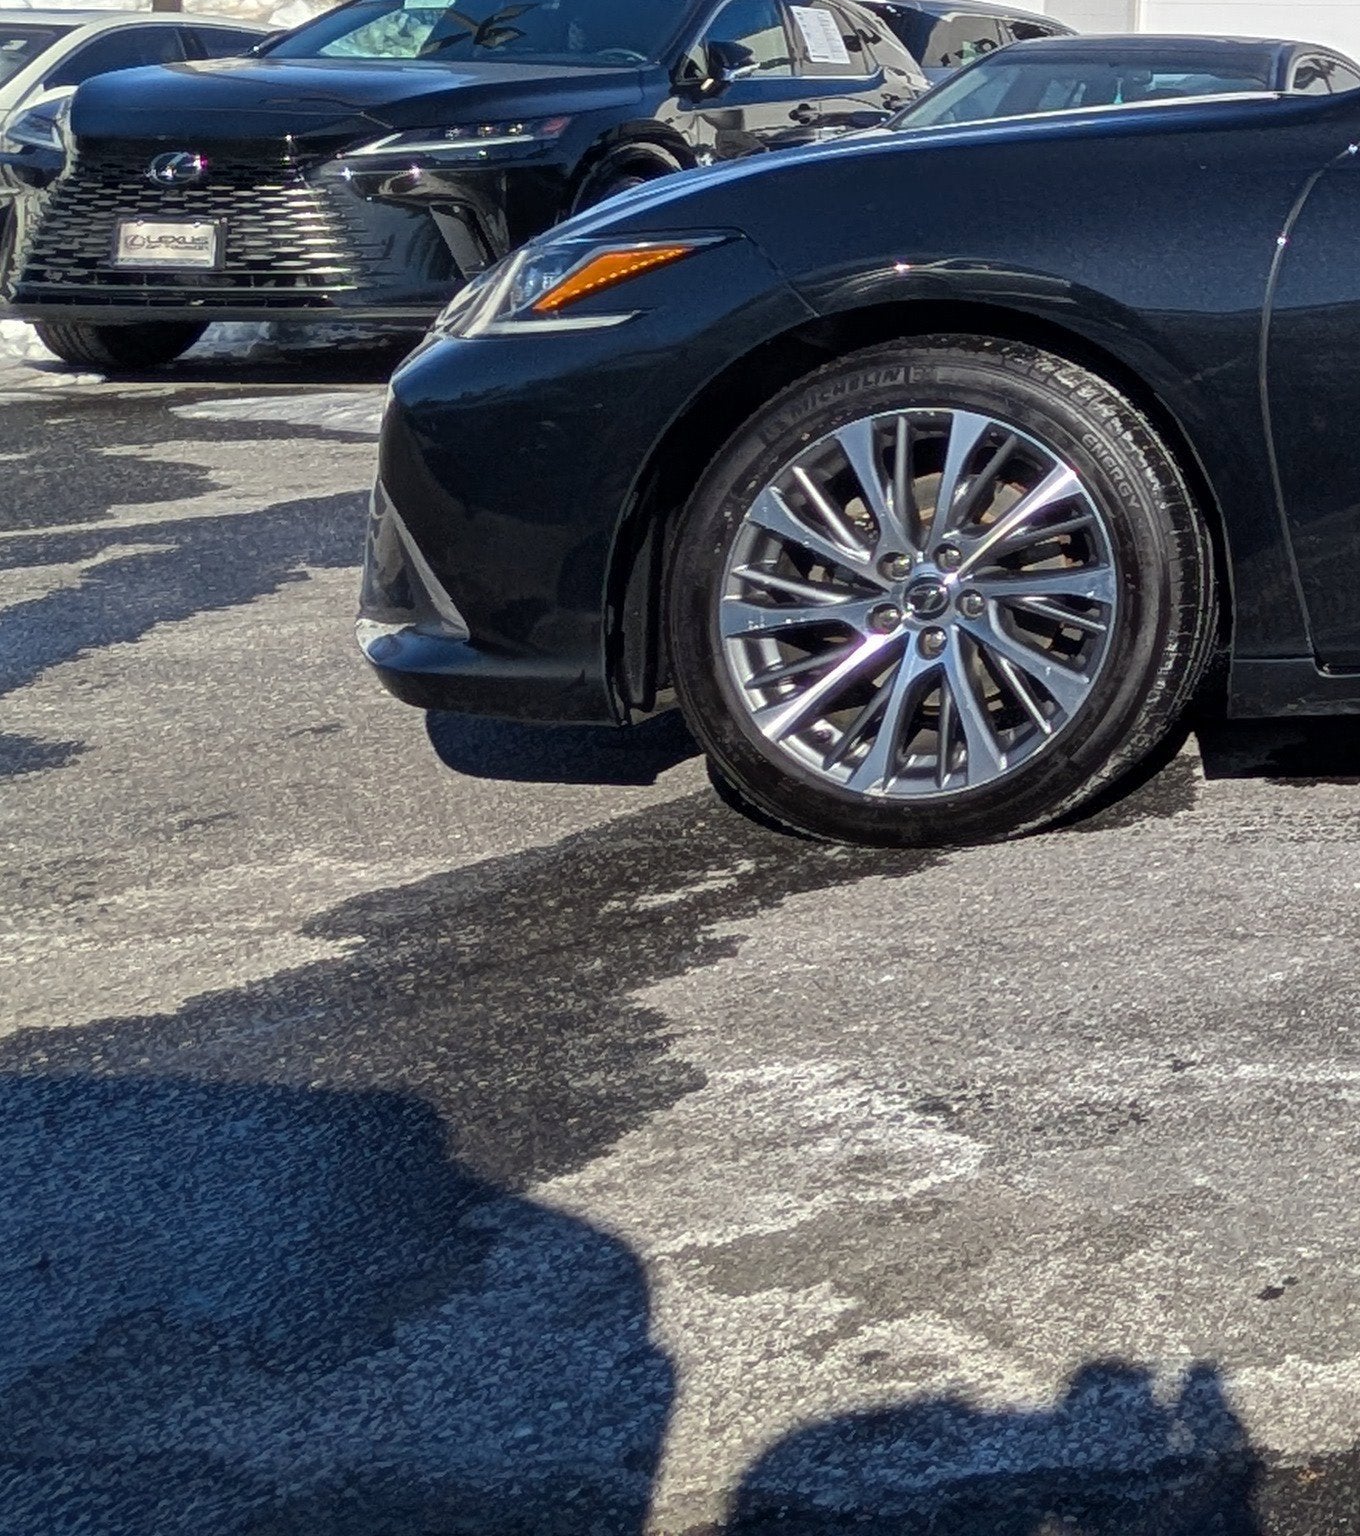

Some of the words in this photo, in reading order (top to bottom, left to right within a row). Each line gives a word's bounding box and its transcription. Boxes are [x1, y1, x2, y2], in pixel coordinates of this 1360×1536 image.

[146, 235, 209, 245] LEXUS
[787, 365, 906, 421] MICHELIN
[1081, 432, 1142, 509] ENERGY
